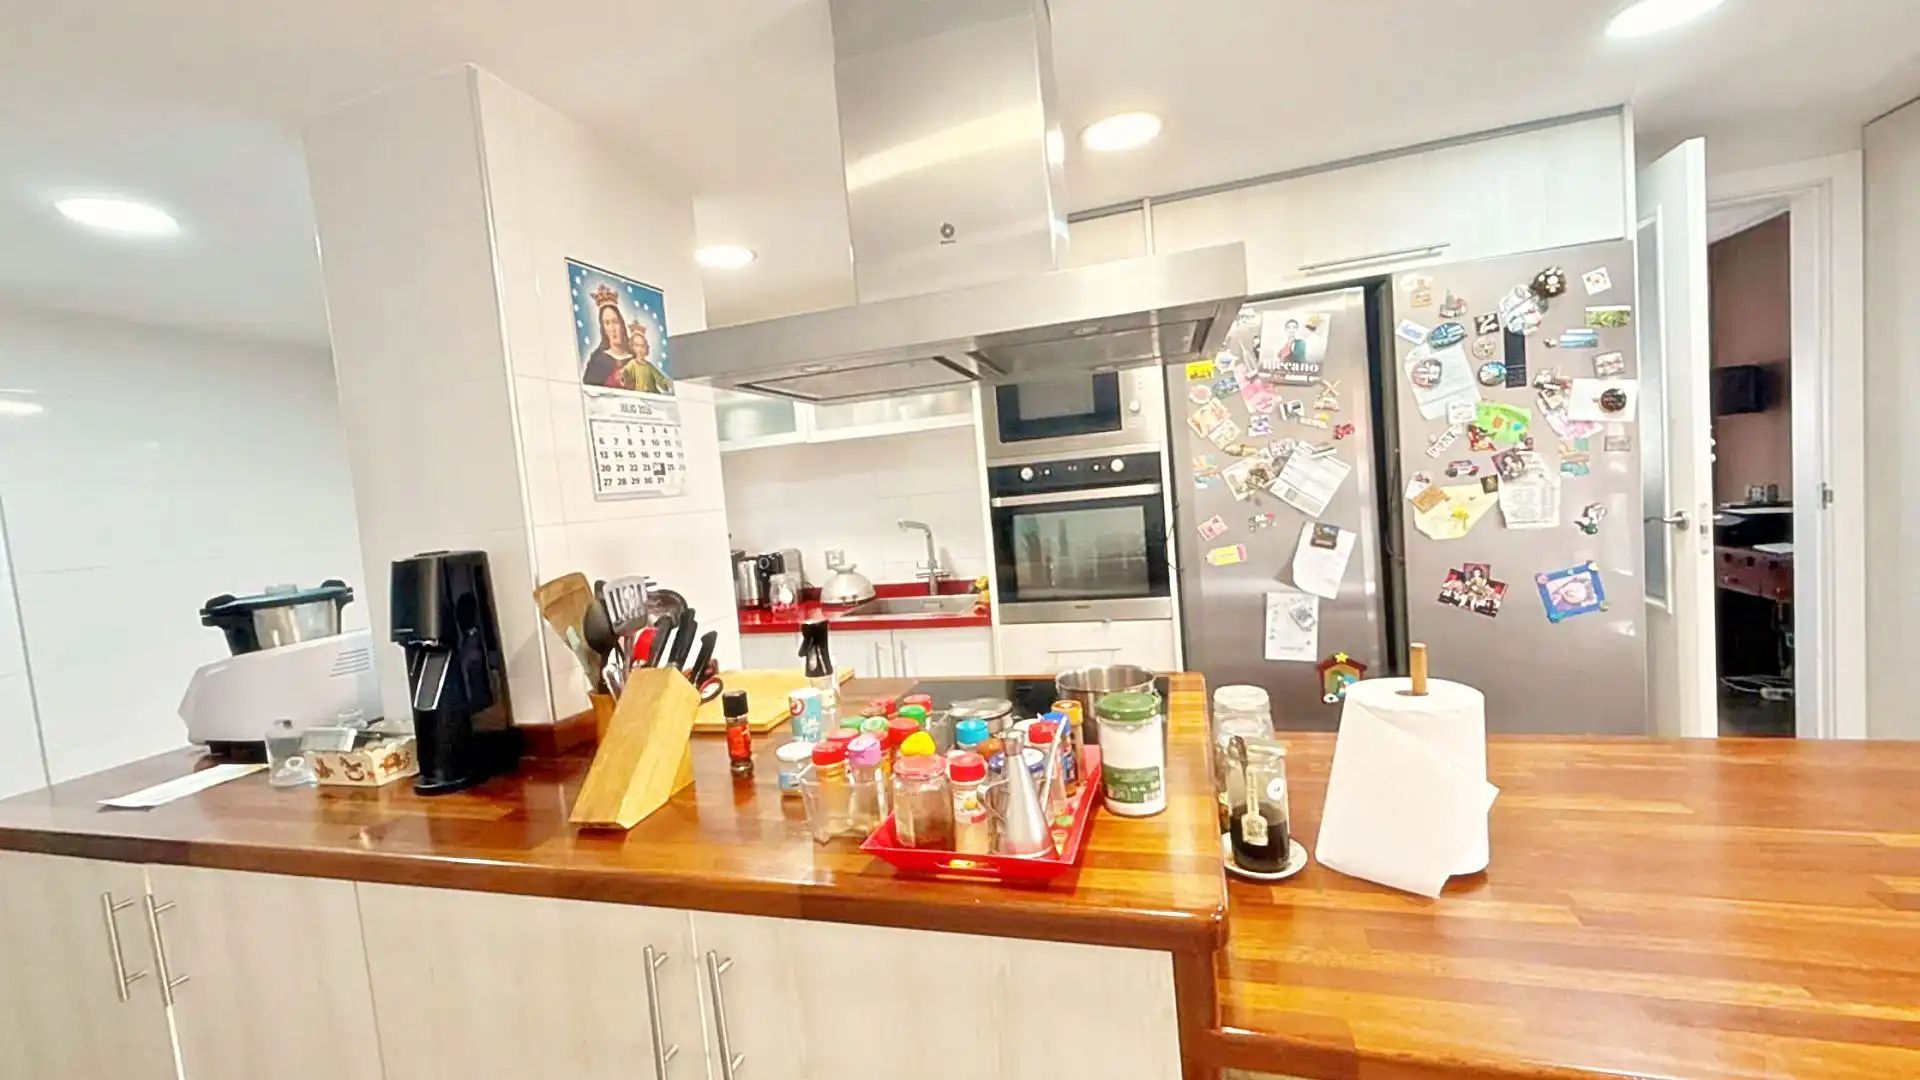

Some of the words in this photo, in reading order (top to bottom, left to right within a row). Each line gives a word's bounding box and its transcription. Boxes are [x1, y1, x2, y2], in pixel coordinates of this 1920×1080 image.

[1262, 360, 1319, 373] mecano
[625, 425, 631, 433] 1
[598, 437, 605, 445] 6
[613, 438, 619, 446] 7
[664, 439, 671, 447] 11
[600, 451, 608, 459] 13
[614, 451, 623, 459] 14
[628, 451, 636, 459] 15
[665, 451, 673, 459] 18
[601, 464, 611, 472] 20
[616, 464, 625, 472] 21
[629, 464, 638, 472] 22
[603, 478, 613, 486] 27
[617, 478, 627, 486] 28
[631, 477, 640, 485] 29
